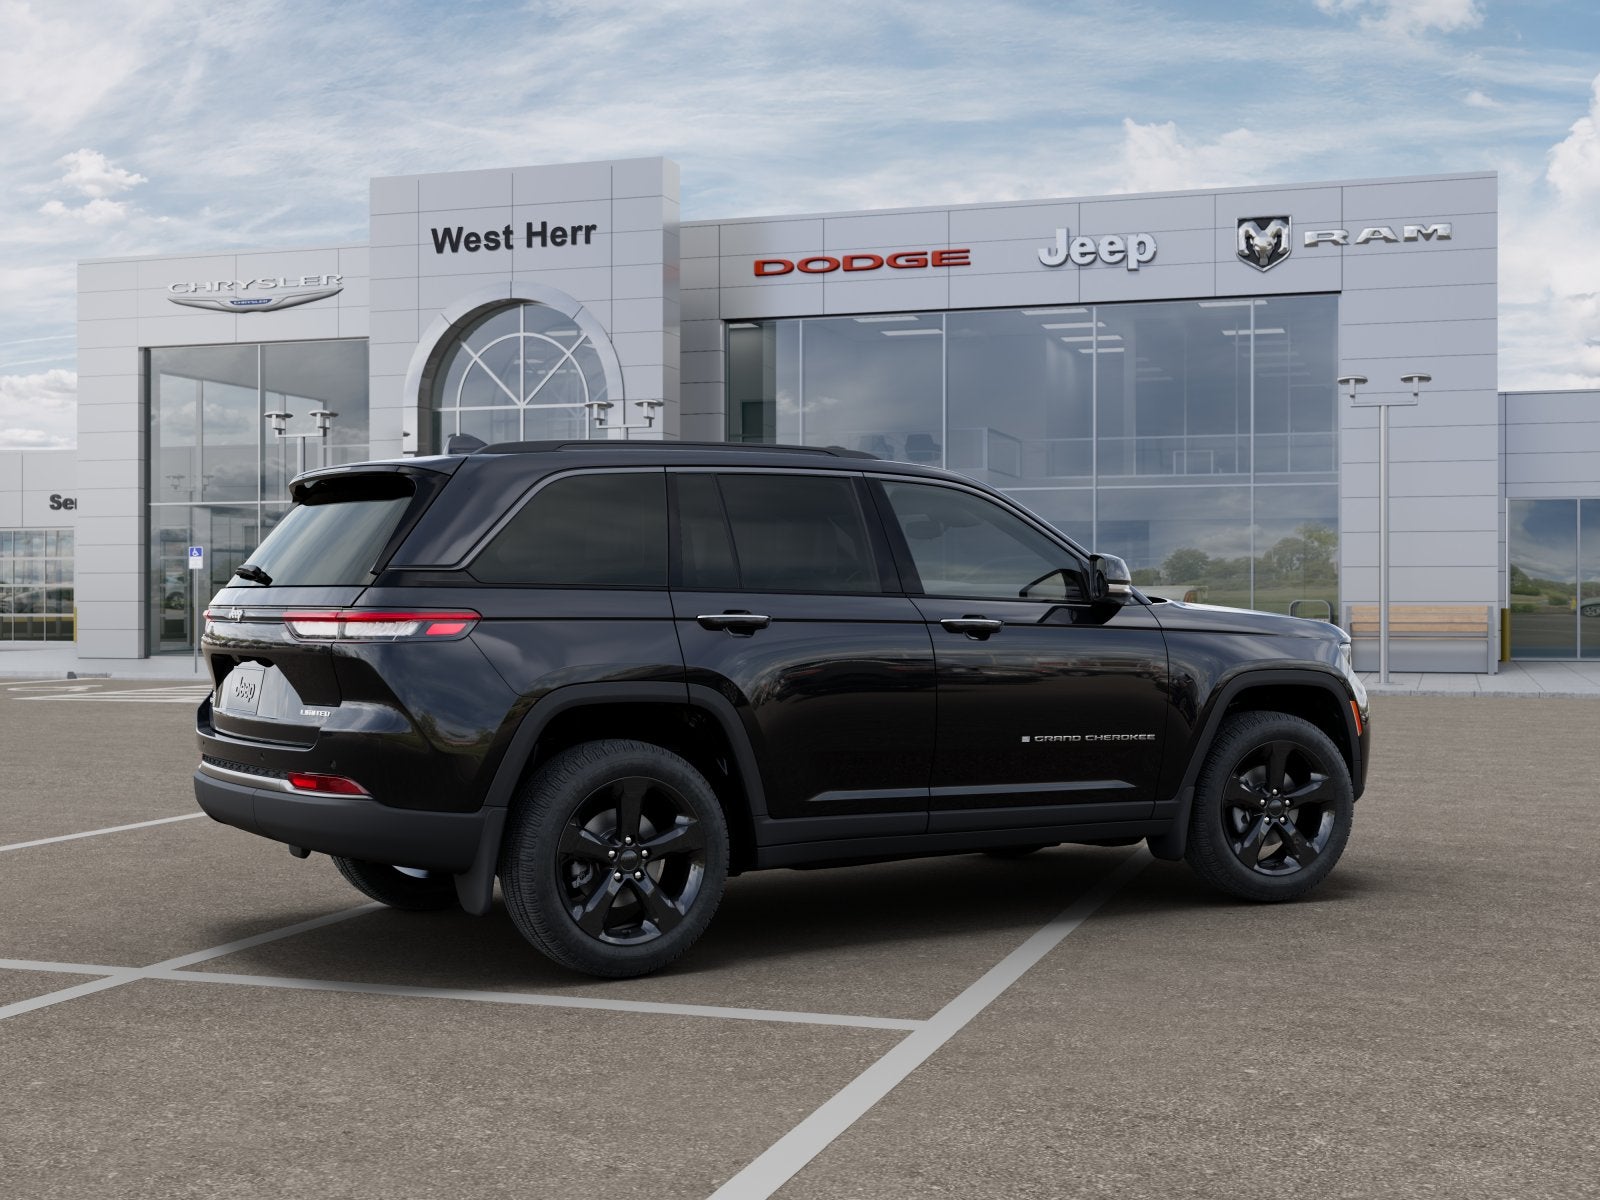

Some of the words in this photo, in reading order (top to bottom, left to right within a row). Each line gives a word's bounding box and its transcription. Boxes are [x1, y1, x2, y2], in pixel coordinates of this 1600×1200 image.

[431, 224, 514, 254] West
[526, 221, 597, 248] Herr
[1303, 222, 1452, 247] RAM
[754, 248, 971, 277] DODGE
[1038, 227, 1157, 271] Jeep
[167, 273, 343, 294] CHRYSLER
[235, 676, 256, 703] Jeep
